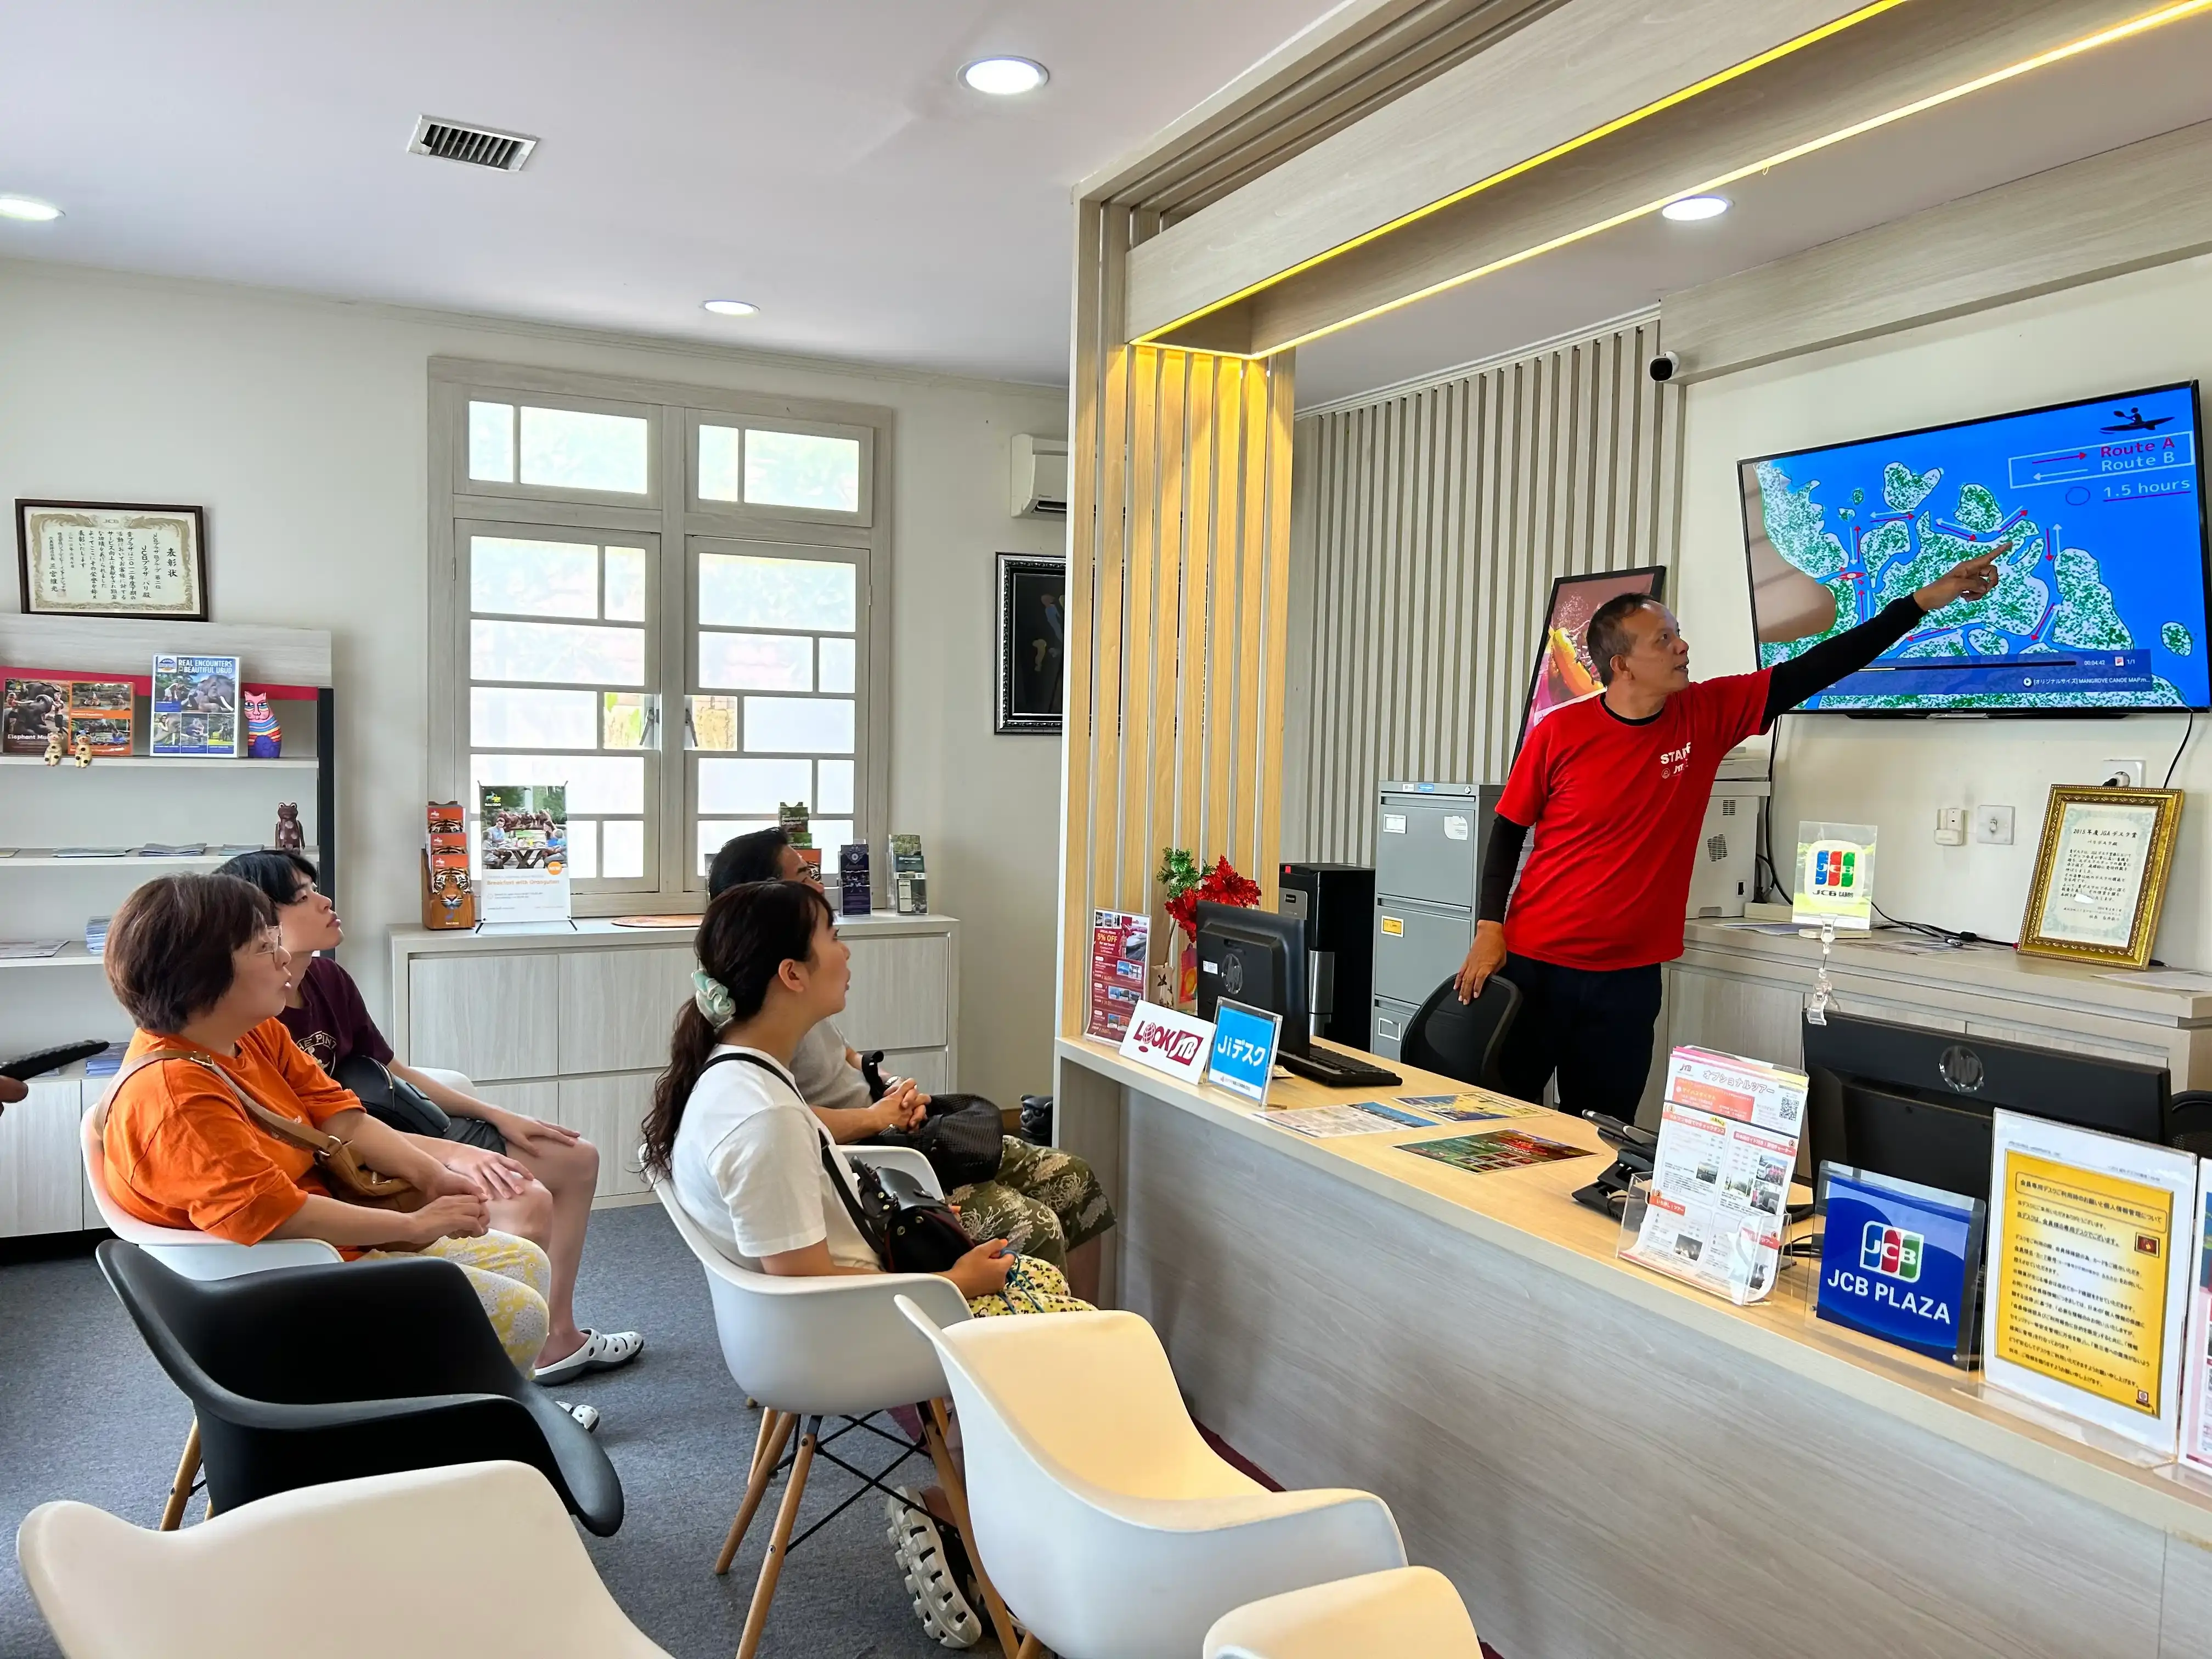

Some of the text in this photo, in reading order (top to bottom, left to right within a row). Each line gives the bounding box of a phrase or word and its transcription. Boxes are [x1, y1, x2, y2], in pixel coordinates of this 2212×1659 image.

[2100, 437, 2175, 458] Route A
[2101, 452, 2175, 472] Route B
[2103, 478, 2191, 498] 1.5 hours
[166, 547, 178, 577] 表彰状
[1097, 933, 1106, 941] 5%
[1133, 1020, 1177, 1052] LOOK
[1217, 1035, 1266, 1067] Jiデスク
[1679, 1062, 1692, 1074] JTB
[1702, 1068, 1776, 1097] オプショナルツアー
[1827, 1269, 1951, 1325] JCB PLAZA
